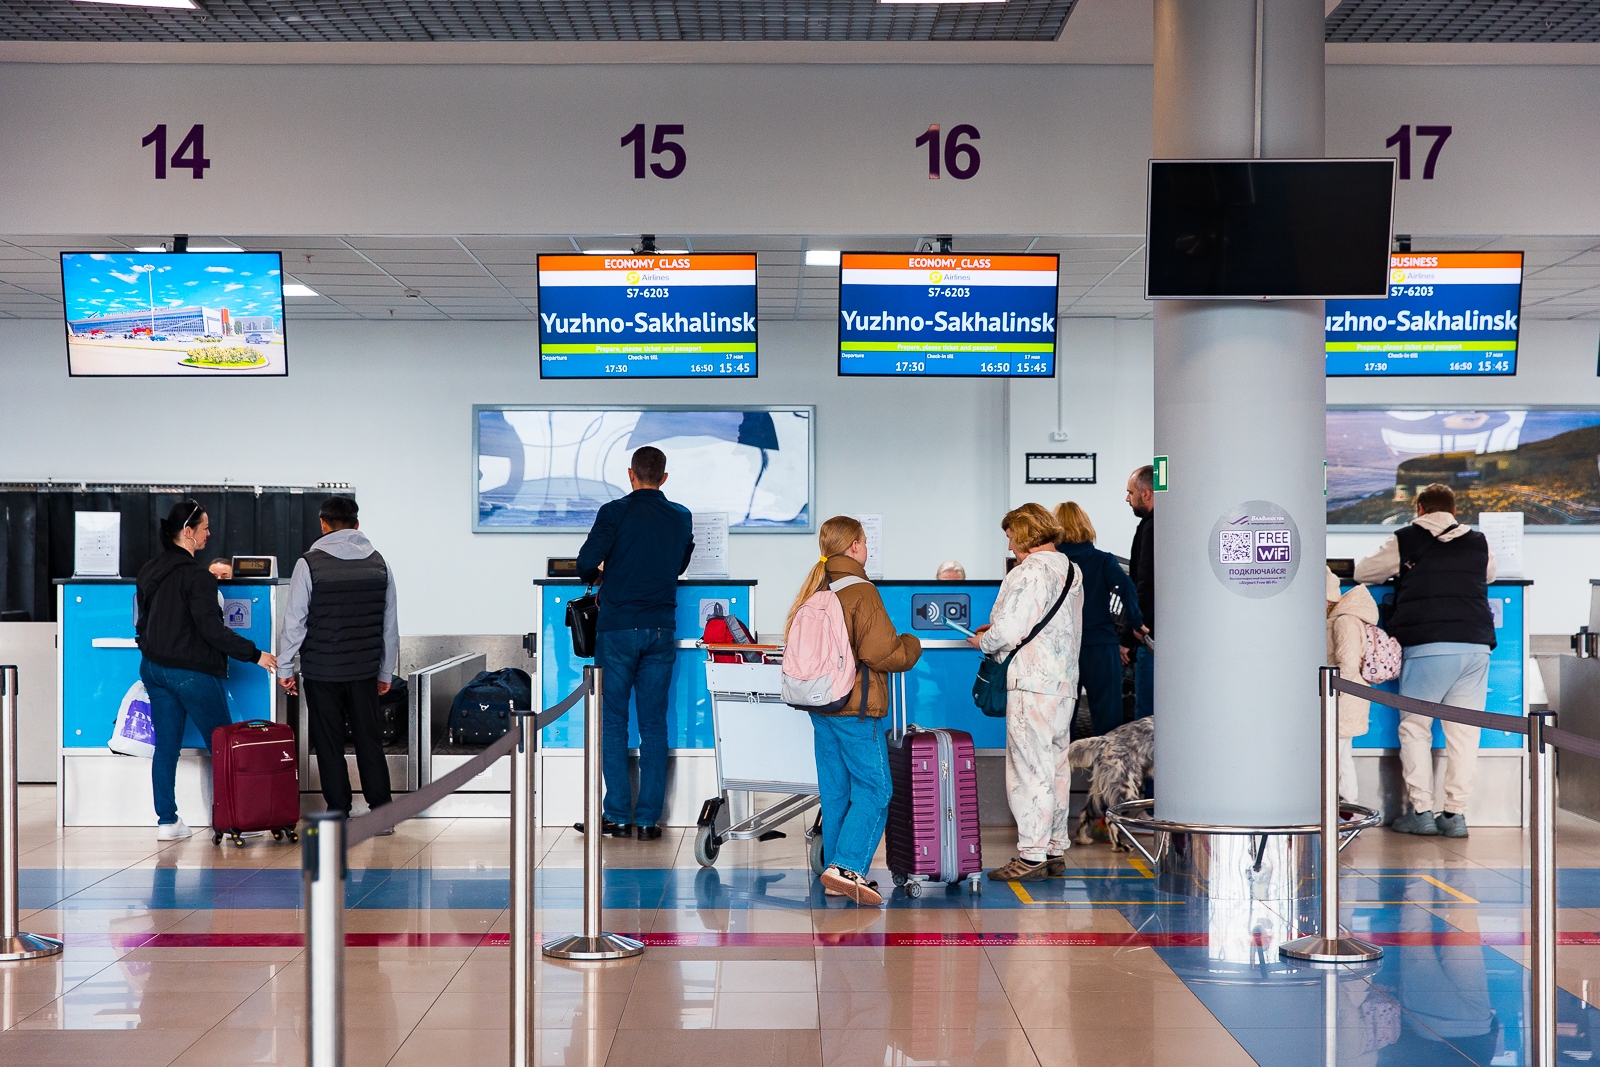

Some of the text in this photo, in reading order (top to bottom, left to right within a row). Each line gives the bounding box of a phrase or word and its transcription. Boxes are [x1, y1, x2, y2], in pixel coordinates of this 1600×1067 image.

[141, 124, 210, 180] 14
[621, 123, 687, 179] 15
[915, 123, 981, 180] 16
[1386, 124, 1452, 180] 17
[604, 258, 691, 270] ECONOMY_CLASS
[908, 258, 991, 270] ECONOMY_CLASS
[1390, 257, 1438, 267] BUSINESS
[642, 273, 670, 281] Airlines
[944, 273, 971, 281] Airlines
[1407, 272, 1435, 280] Airlines
[626, 288, 669, 298] S7-6203
[928, 287, 970, 297] S7-6203
[1391, 286, 1434, 297] S7-6203
[540, 311, 756, 333] Yuzhno-Sakhalinsk
[841, 310, 1055, 332] Yuzhno-Sakhalinsk
[595, 345, 621, 353] Prepare,
[622, 345, 642, 353] please
[675, 345, 702, 353] passport
[922, 344, 941, 352] please
[1436, 343, 1462, 351] passport
[605, 365, 628, 373] 17:30
[690, 364, 713, 373] 16:50
[719, 362, 750, 373] 15:45
[895, 362, 925, 371] 17:30
[980, 362, 1010, 372] 16:50
[1017, 362, 1047, 372] 15:45
[1364, 362, 1387, 371] 17:30
[1449, 362, 1472, 371] 16:50
[1477, 360, 1509, 371] 15:45
[1258, 532, 1288, 544] FREE
[1258, 547, 1289, 561] WiFi
[1229, 568, 1286, 576] ПОДКЛЮЧАЙСЯ!
